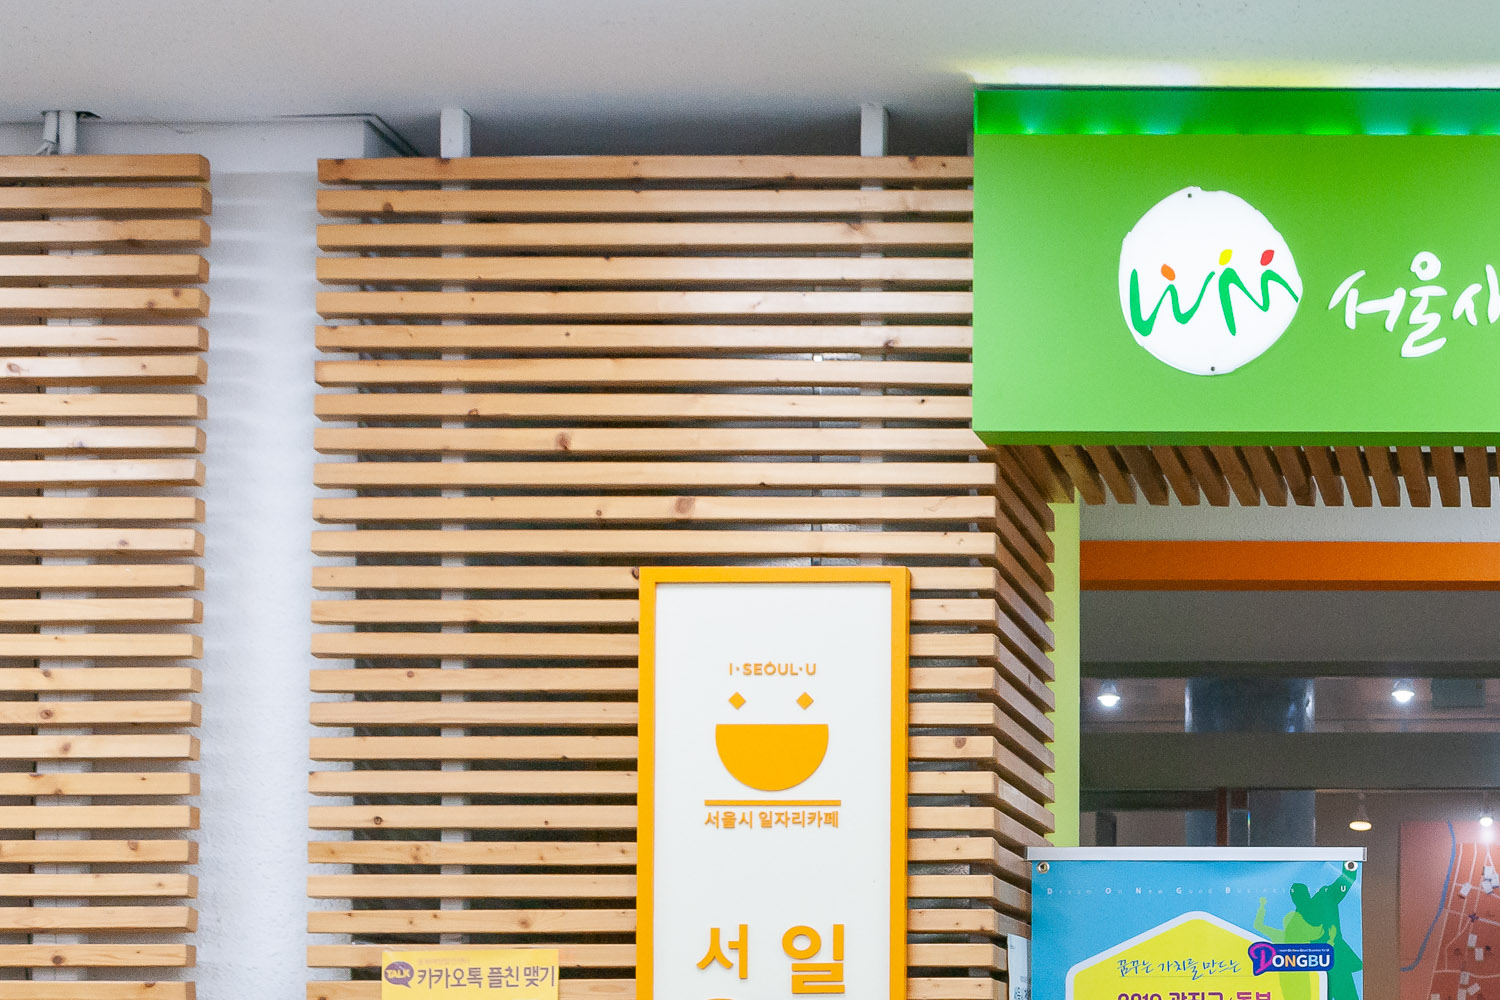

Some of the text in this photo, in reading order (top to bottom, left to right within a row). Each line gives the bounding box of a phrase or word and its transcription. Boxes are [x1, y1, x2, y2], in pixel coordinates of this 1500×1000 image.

[703, 810, 840, 830] 서울시 일자리카페
[417, 965, 555, 989] 카카오톡 플친 맺기
[1115, 958, 1243, 980] 꿈꾸는 가치를 만드는
